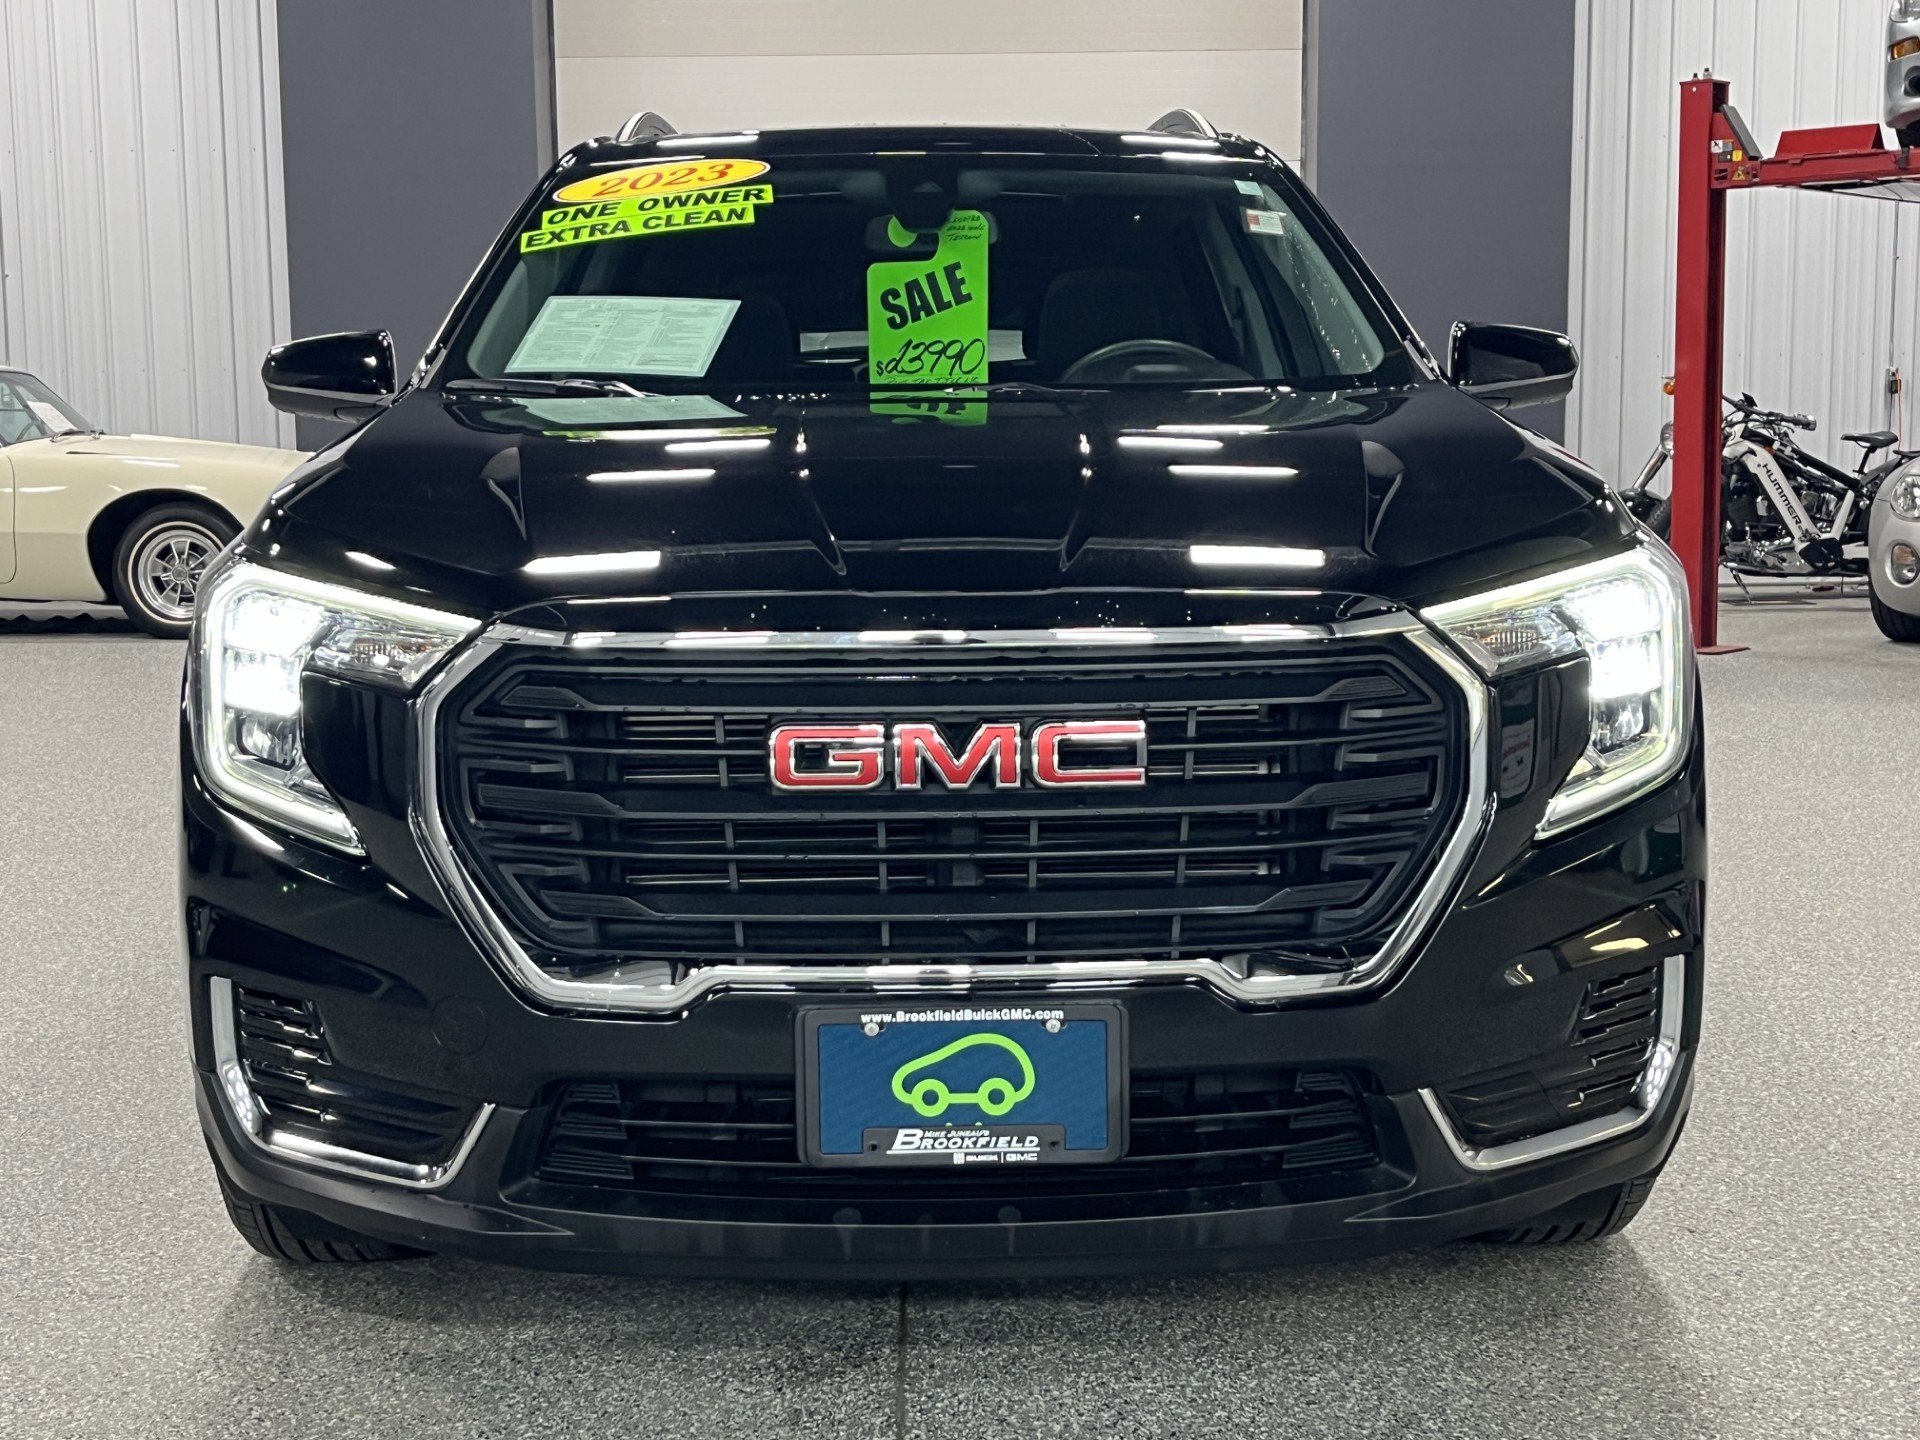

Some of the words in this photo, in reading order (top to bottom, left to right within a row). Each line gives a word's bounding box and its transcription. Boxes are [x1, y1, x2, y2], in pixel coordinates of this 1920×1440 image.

[592, 164, 734, 197] 2023
[547, 202, 622, 225] ONE
[637, 188, 768, 212] OWNER
[525, 220, 631, 249] EXTRA
[642, 207, 748, 230] CLEAN
[880, 261, 973, 330] SALE
[1762, 463, 1802, 525] HUMMER
[769, 720, 1147, 791] GMC
[861, 1008, 1065, 1023] www.BrookfieldBuickGMC.com
[892, 1128, 1040, 1150] BROOKFIELD
[1006, 1152, 1038, 1161] GMC
